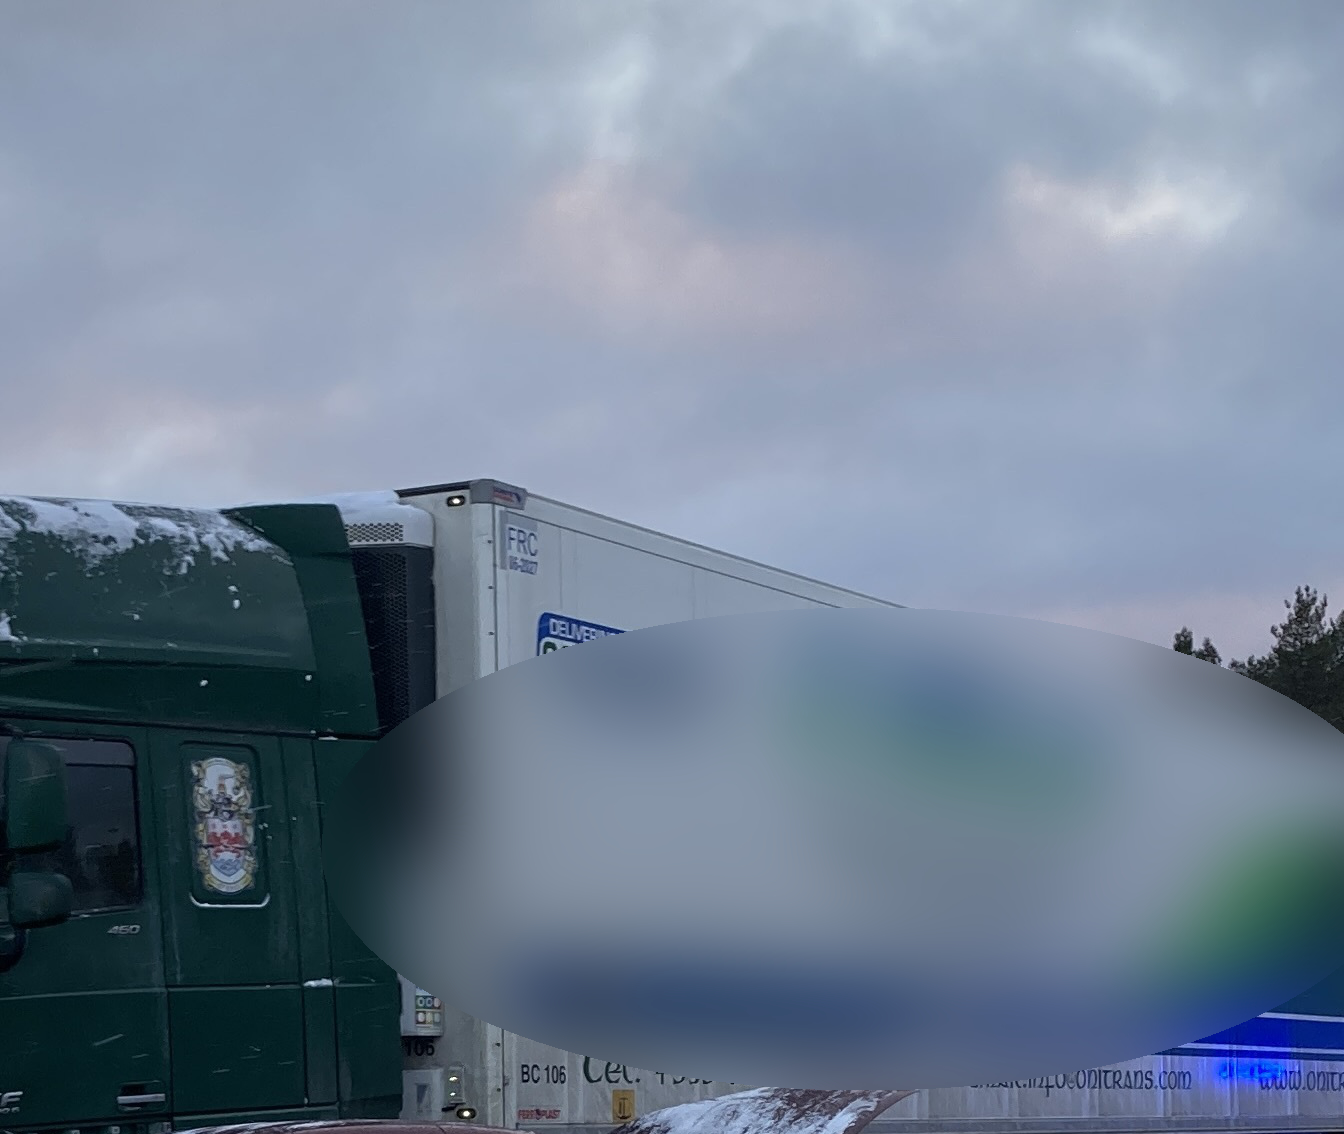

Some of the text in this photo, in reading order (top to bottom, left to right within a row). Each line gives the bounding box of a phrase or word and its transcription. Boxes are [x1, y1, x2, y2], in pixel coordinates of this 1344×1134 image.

[508, 526, 538, 557] FRC
[521, 1064, 567, 1085] BC 106
